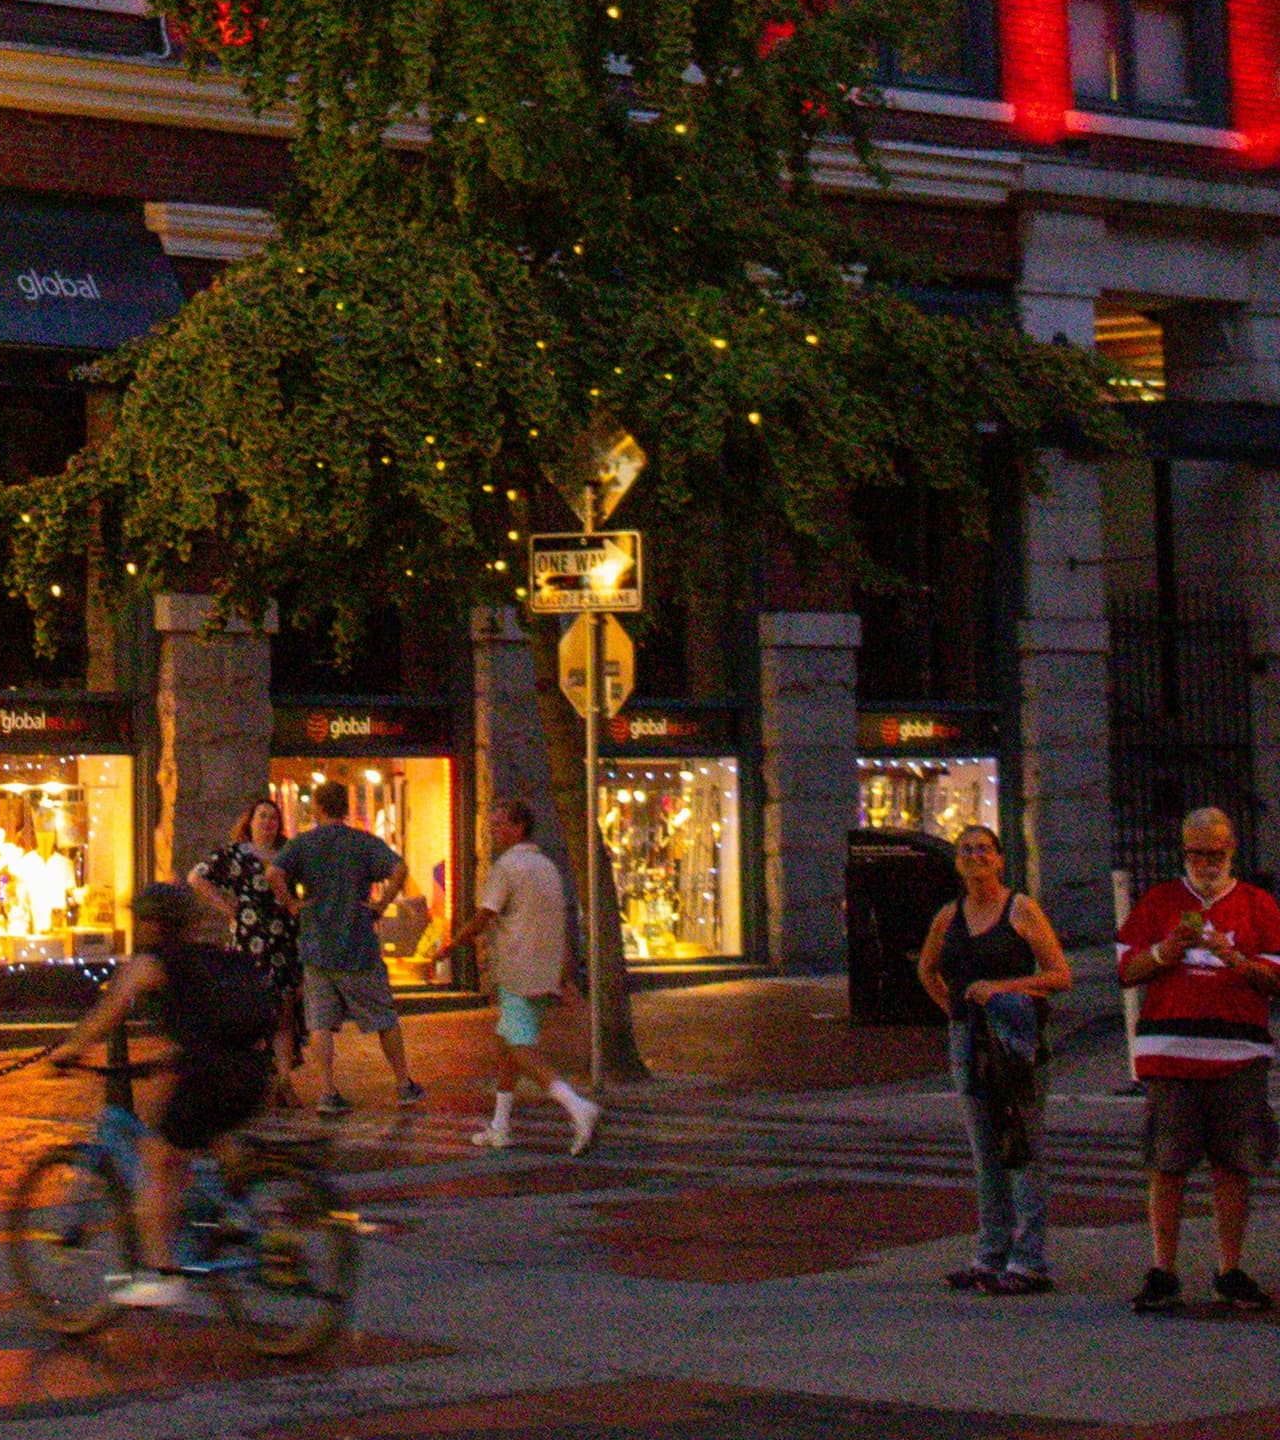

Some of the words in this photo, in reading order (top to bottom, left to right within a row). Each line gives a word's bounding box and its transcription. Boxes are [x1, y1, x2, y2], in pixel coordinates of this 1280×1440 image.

[17, 267, 100, 301] global
[537, 554, 568, 573] ONE
[574, 552, 607, 572] WAY
[1, 710, 46, 734] global
[330, 716, 371, 740] global
[630, 717, 667, 740] global
[899, 720, 933, 742] global
